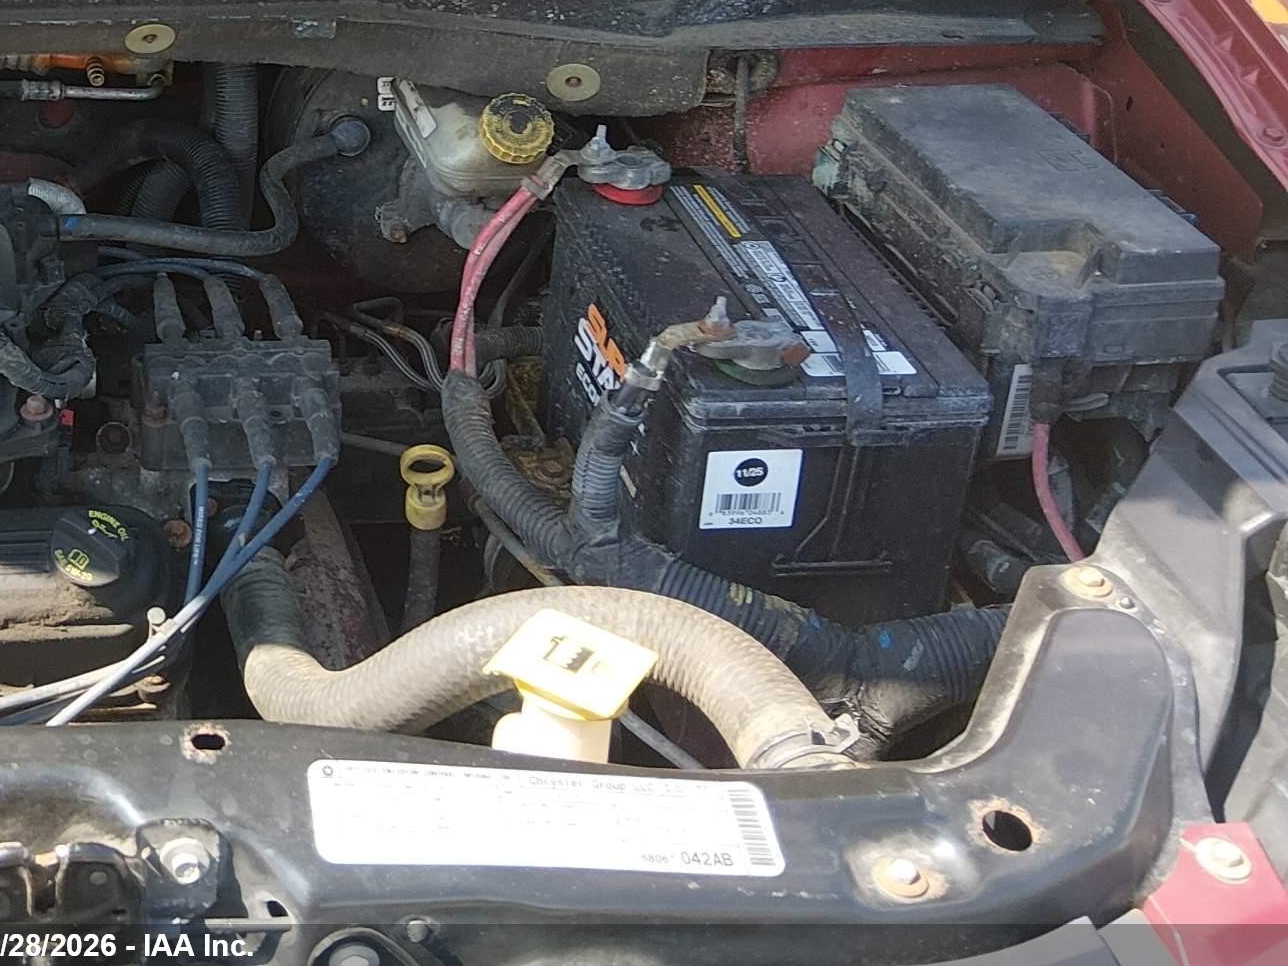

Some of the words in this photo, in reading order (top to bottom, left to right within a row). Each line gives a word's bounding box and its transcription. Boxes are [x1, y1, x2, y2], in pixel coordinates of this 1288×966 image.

[574, 317, 621, 390] STA
[588, 303, 626, 380] SUP
[88, 509, 121, 529] ENGINE
[118, 527, 130, 542] OIL
[680, 851, 734, 867] 042AB
